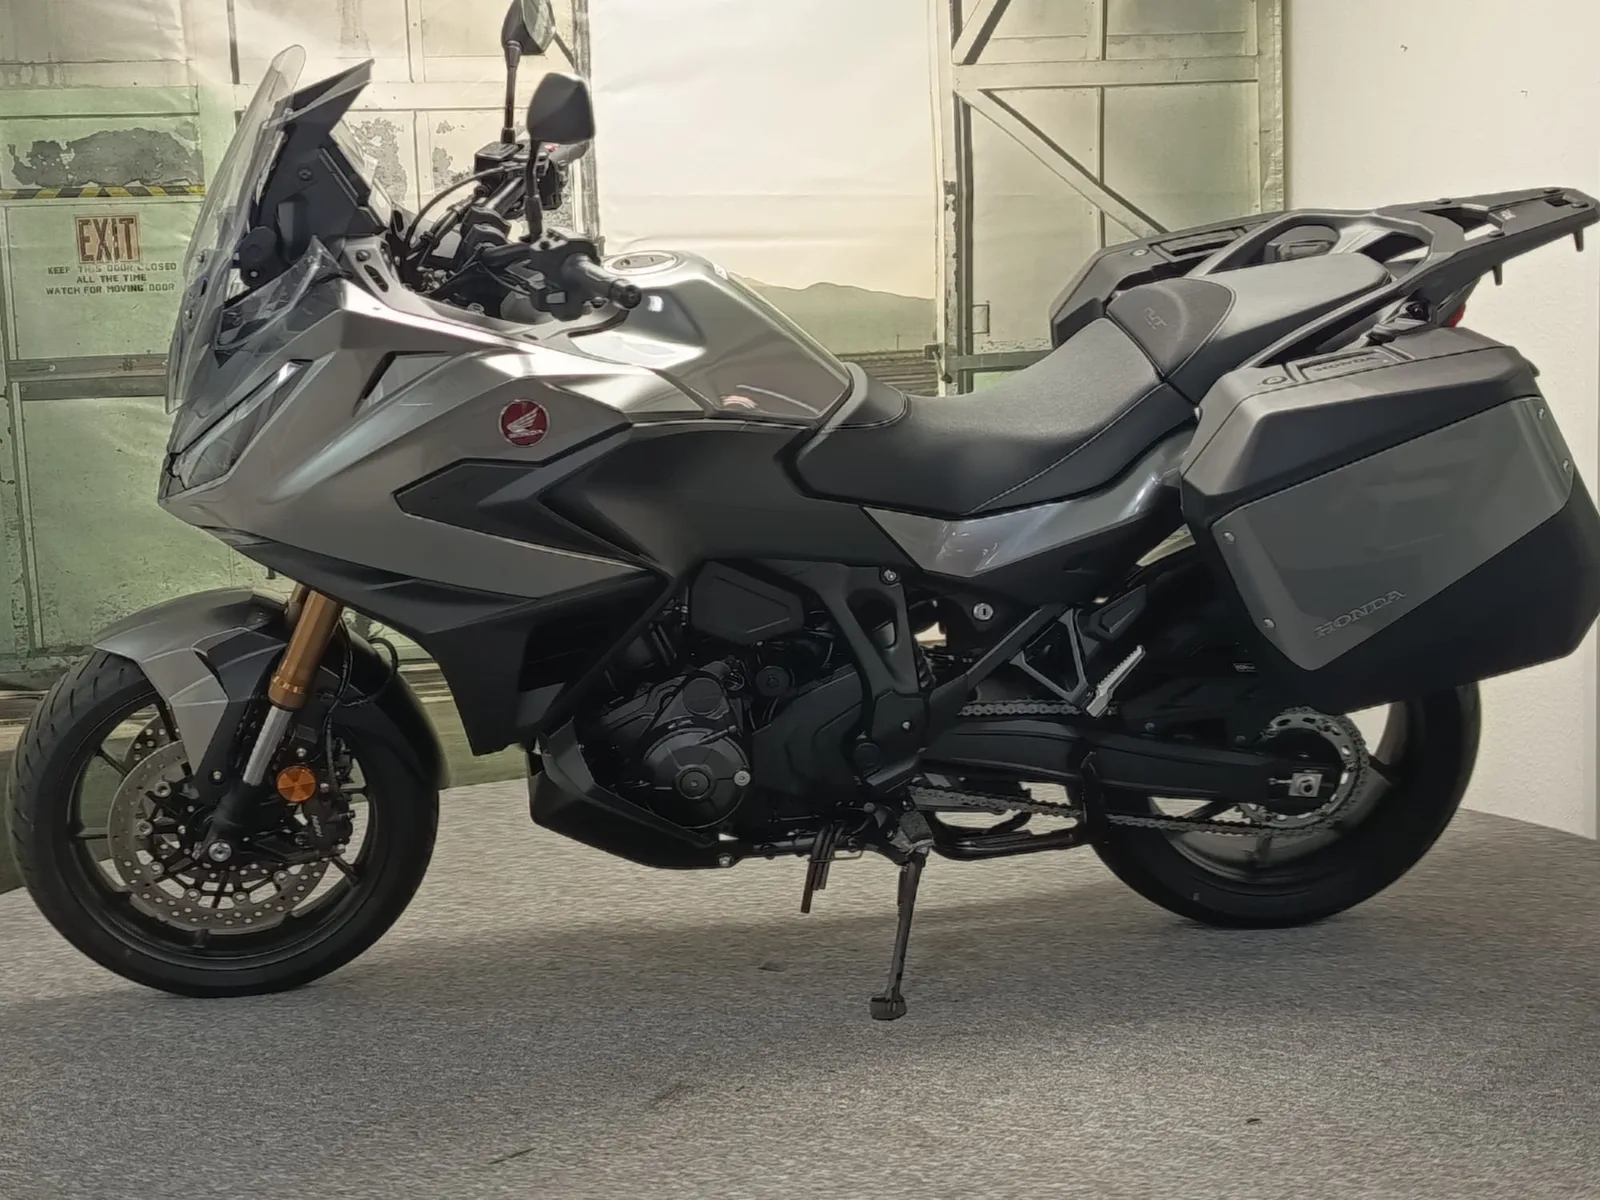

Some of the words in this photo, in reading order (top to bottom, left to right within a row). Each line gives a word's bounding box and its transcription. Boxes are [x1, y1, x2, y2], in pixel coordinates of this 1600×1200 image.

[78, 217, 134, 261] EXIT
[78, 264, 101, 273] THIS
[137, 262, 177, 272] CLOSED
[76, 275, 95, 284] ALL
[123, 273, 147, 282] TIME
[45, 286, 80, 295] WATCH
[83, 285, 102, 294] FOR
[106, 284, 144, 293] MOVING
[148, 283, 175, 291] DOOR
[1313, 590, 1406, 640] HONDA
